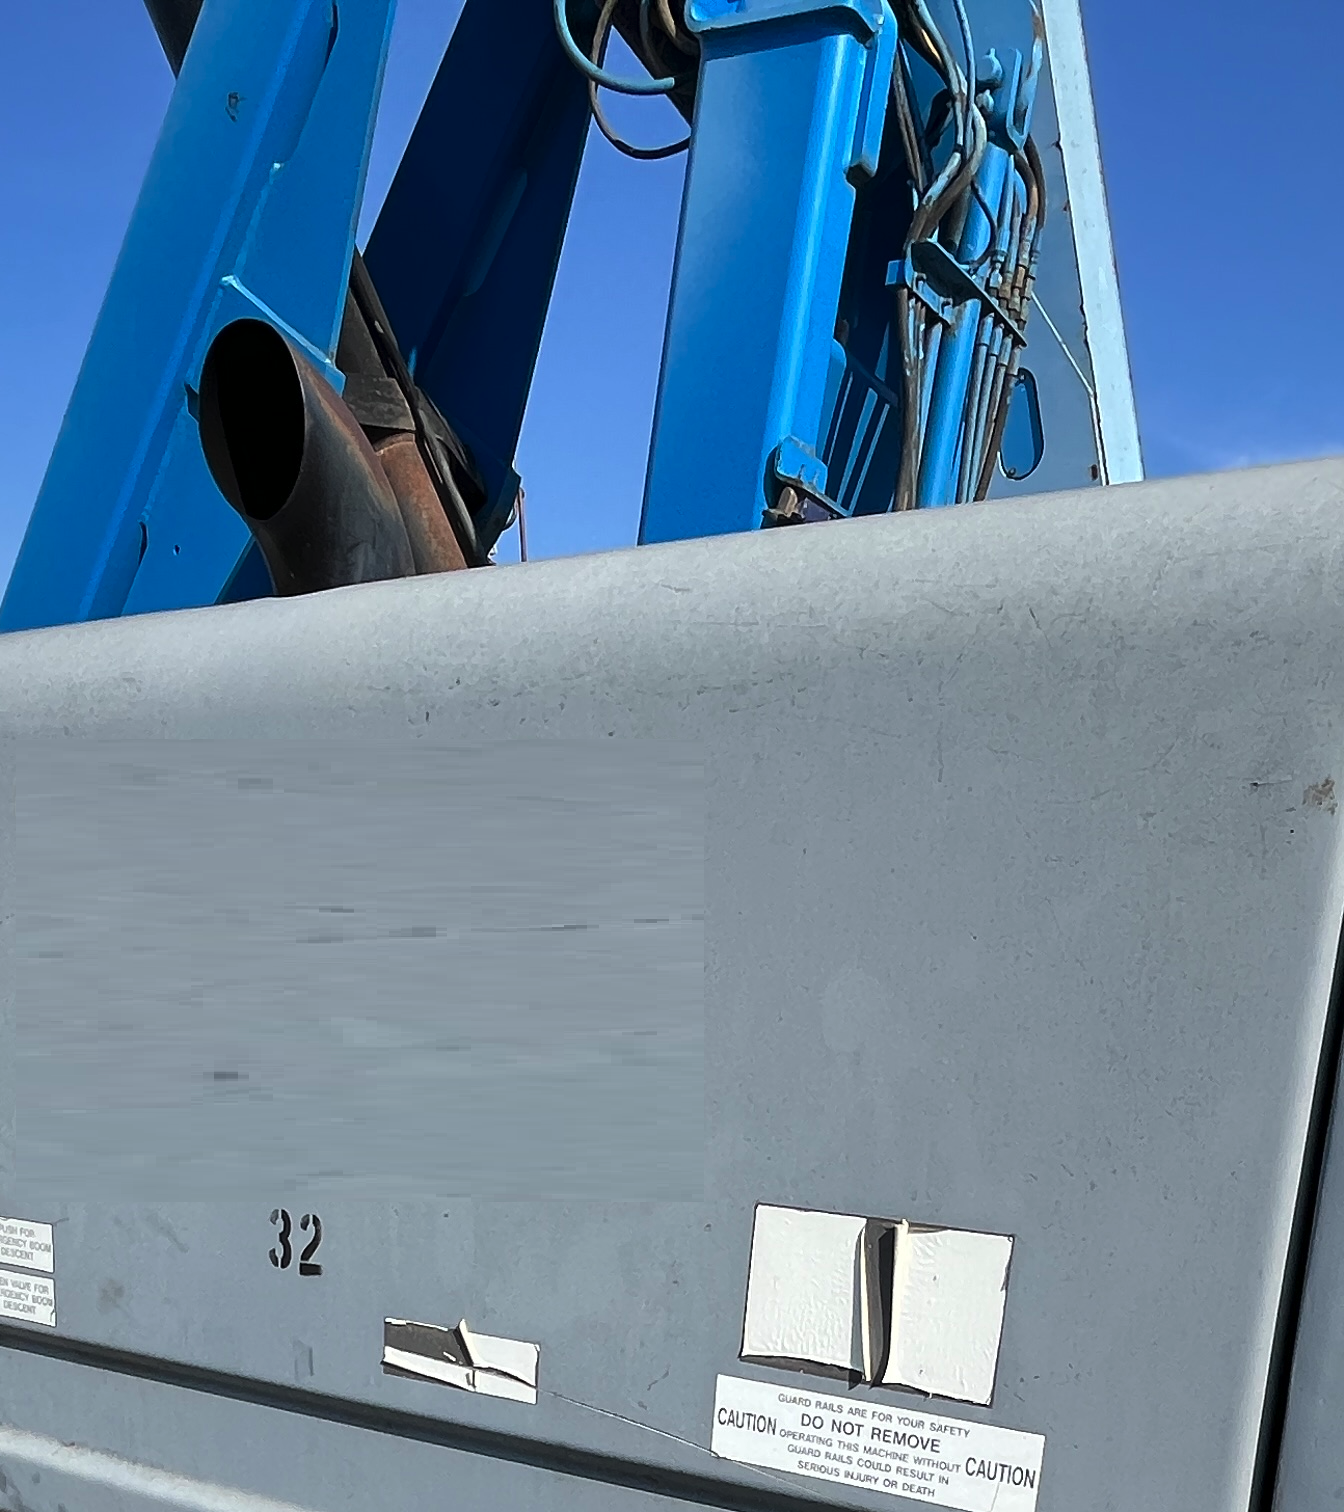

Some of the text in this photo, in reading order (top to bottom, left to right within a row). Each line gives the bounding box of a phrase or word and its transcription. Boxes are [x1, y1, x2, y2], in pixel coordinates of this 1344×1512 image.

[20, 1227, 35, 1238] FOR
[268, 1208, 324, 1277] 32
[0, 1246, 34, 1261] DESCENT
[34, 1283, 49, 1295] FOR
[3, 1299, 36, 1315] DESCENT
[718, 1407, 778, 1435] CAUTION
[778, 1393, 971, 1438] GUARD RAILS ARE FOR YOUR SAFETY
[800, 1413, 941, 1453] DO NOT REMOVE
[779, 1429, 961, 1474] OPERATING THIS MACHINE WITHOUT
[787, 1444, 950, 1486] GUARD RAILS COULD RESULT IN
[797, 1460, 936, 1498] SERIOUS INJURY OR DEATH
[965, 1457, 1036, 1489] CAUTION
